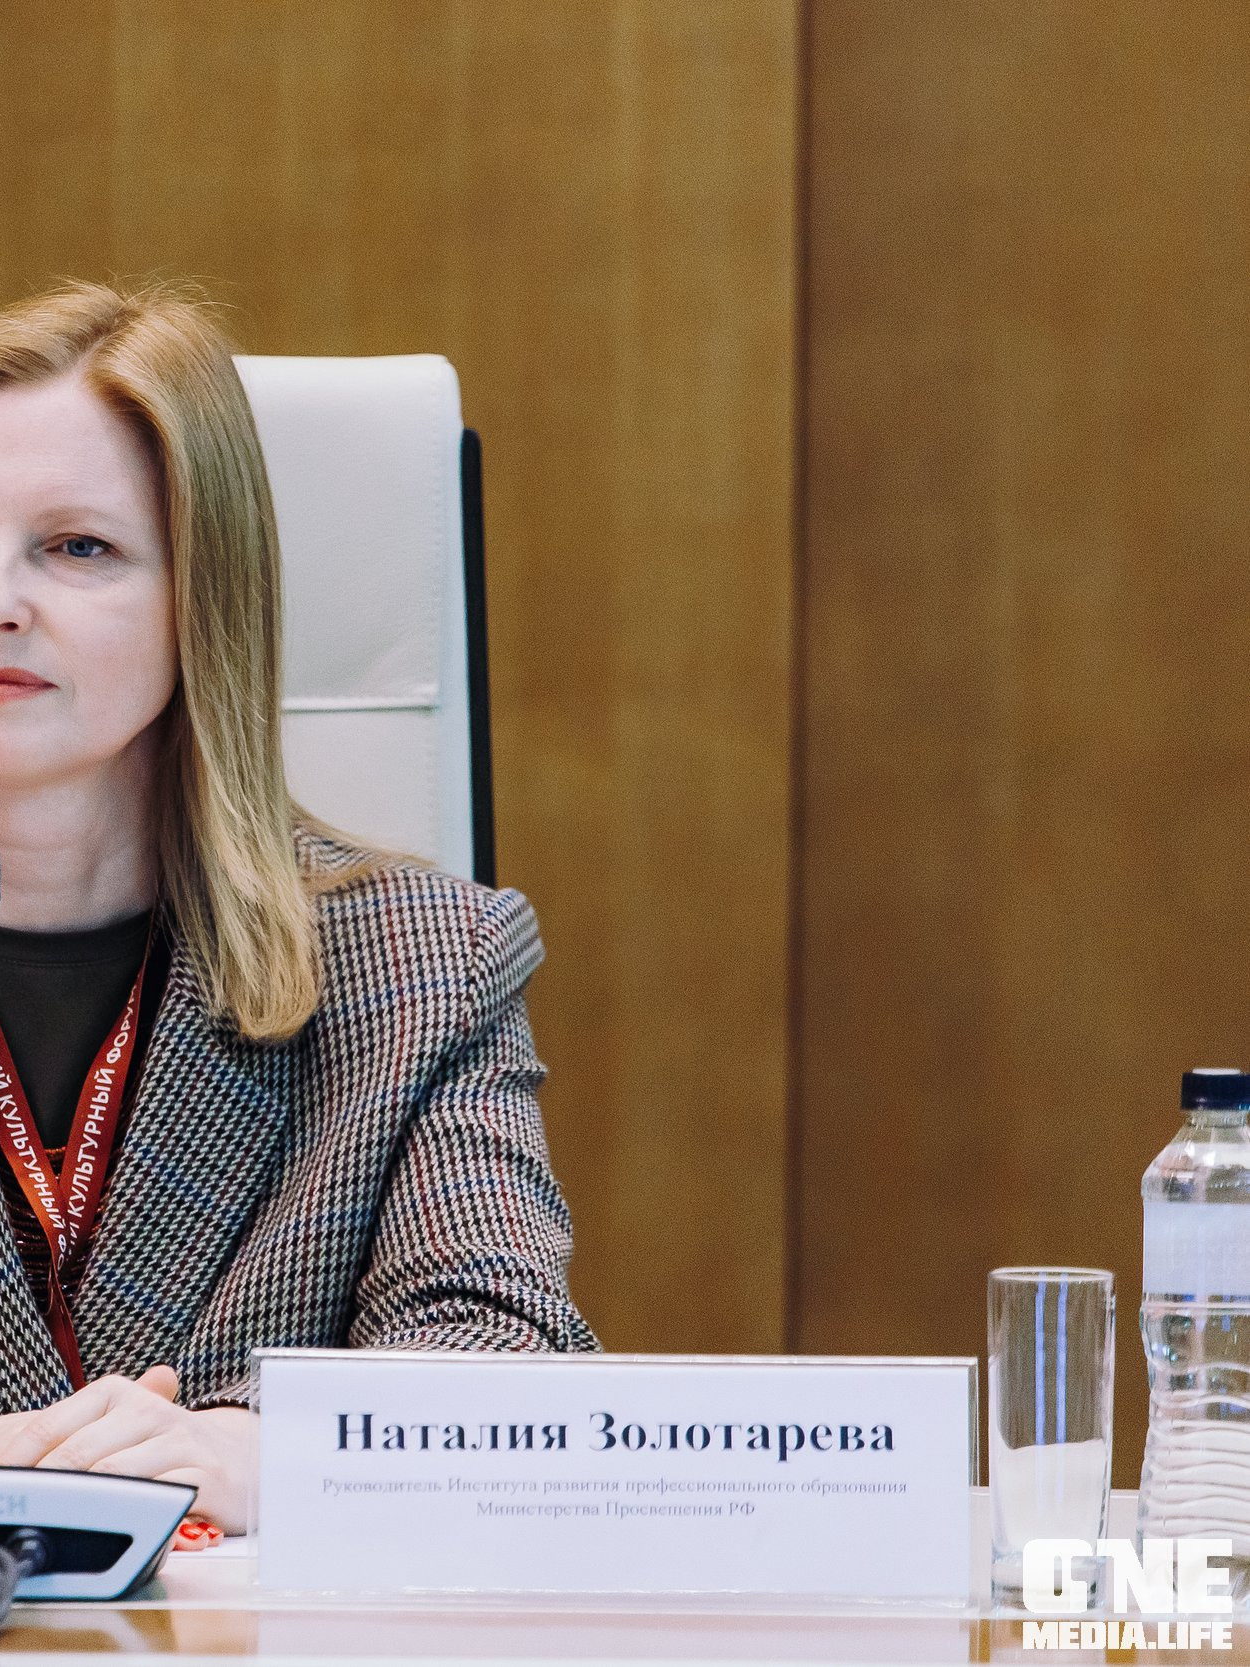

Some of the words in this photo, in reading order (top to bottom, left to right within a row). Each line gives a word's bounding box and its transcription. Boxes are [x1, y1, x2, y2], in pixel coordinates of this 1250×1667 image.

[67, 1068, 115, 1218] КУЛЬТУРНЫЙ
[334, 1412, 568, 1452] Наталия
[588, 1411, 896, 1463] Золотарева
[322, 1478, 442, 1495] Руководитель
[448, 1477, 537, 1496] Института
[543, 1480, 619, 1496] развития
[626, 1477, 795, 1496] профессионального
[800, 1478, 908, 1496] образования
[476, 1501, 599, 1518] Министерства
[605, 1501, 722, 1519] Просвещения
[728, 1501, 756, 1518] РФ
